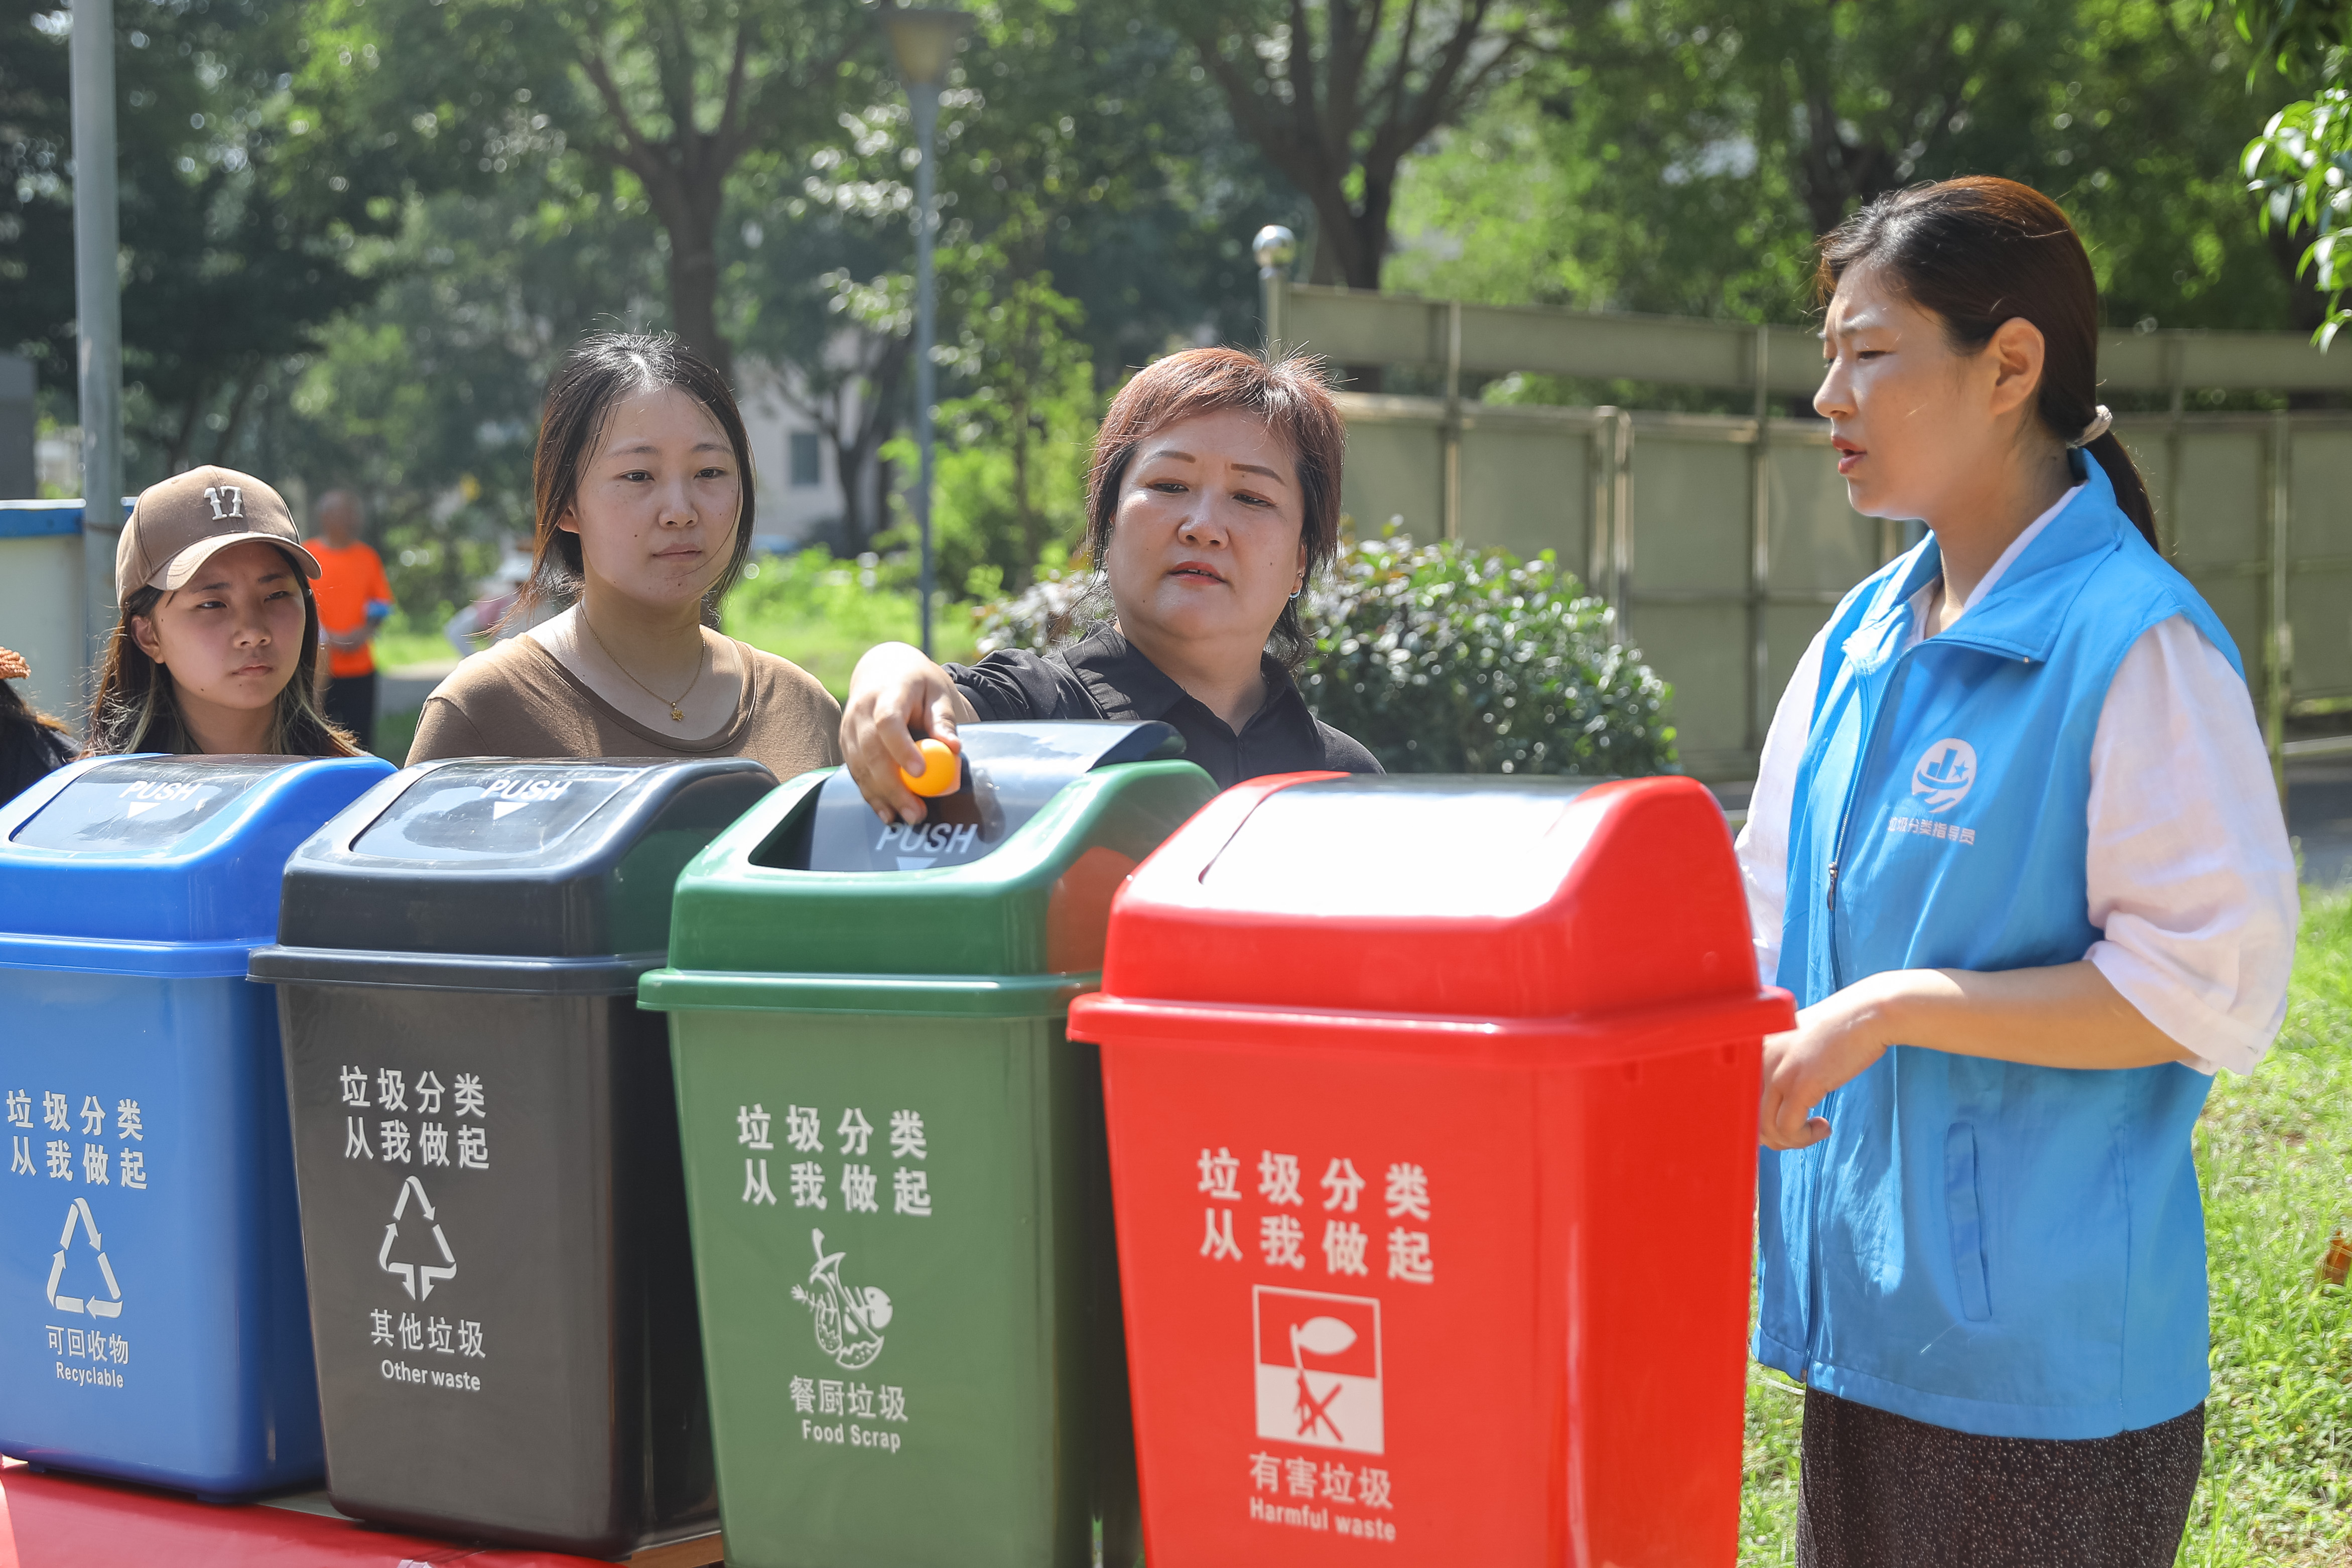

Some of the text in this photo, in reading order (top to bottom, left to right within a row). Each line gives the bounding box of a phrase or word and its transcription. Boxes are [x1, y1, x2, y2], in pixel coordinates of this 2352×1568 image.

[204, 485, 243, 520] 17
[118, 780, 203, 801] PUSH
[479, 779, 573, 801] PUSH
[875, 822, 978, 853] PUSH
[1887, 816, 1976, 845] 垃圾分类指导员
[6, 1089, 144, 1141] 垃圾分类
[340, 1065, 486, 1118] 垃圾分类
[345, 1116, 490, 1169] 从我做起
[737, 1103, 928, 1160] 垃圾分类
[11, 1135, 148, 1190] 从我做起
[1197, 1147, 1430, 1221] 垃圾分类
[742, 1158, 933, 1217] 从我做起
[1200, 1207, 1434, 1284] 从我做起
[45, 1324, 129, 1365] 可回收物
[370, 1308, 486, 1358] 其他垃圾
[56, 1361, 124, 1389] Recyclable
[381, 1359, 481, 1391] Other waste
[789, 1375, 908, 1422] 餐厨垃圾
[802, 1419, 901, 1454] Food Scrap
[1249, 1451, 1393, 1510] 有害垃圾
[1250, 1496, 1397, 1543] Harmful waste
